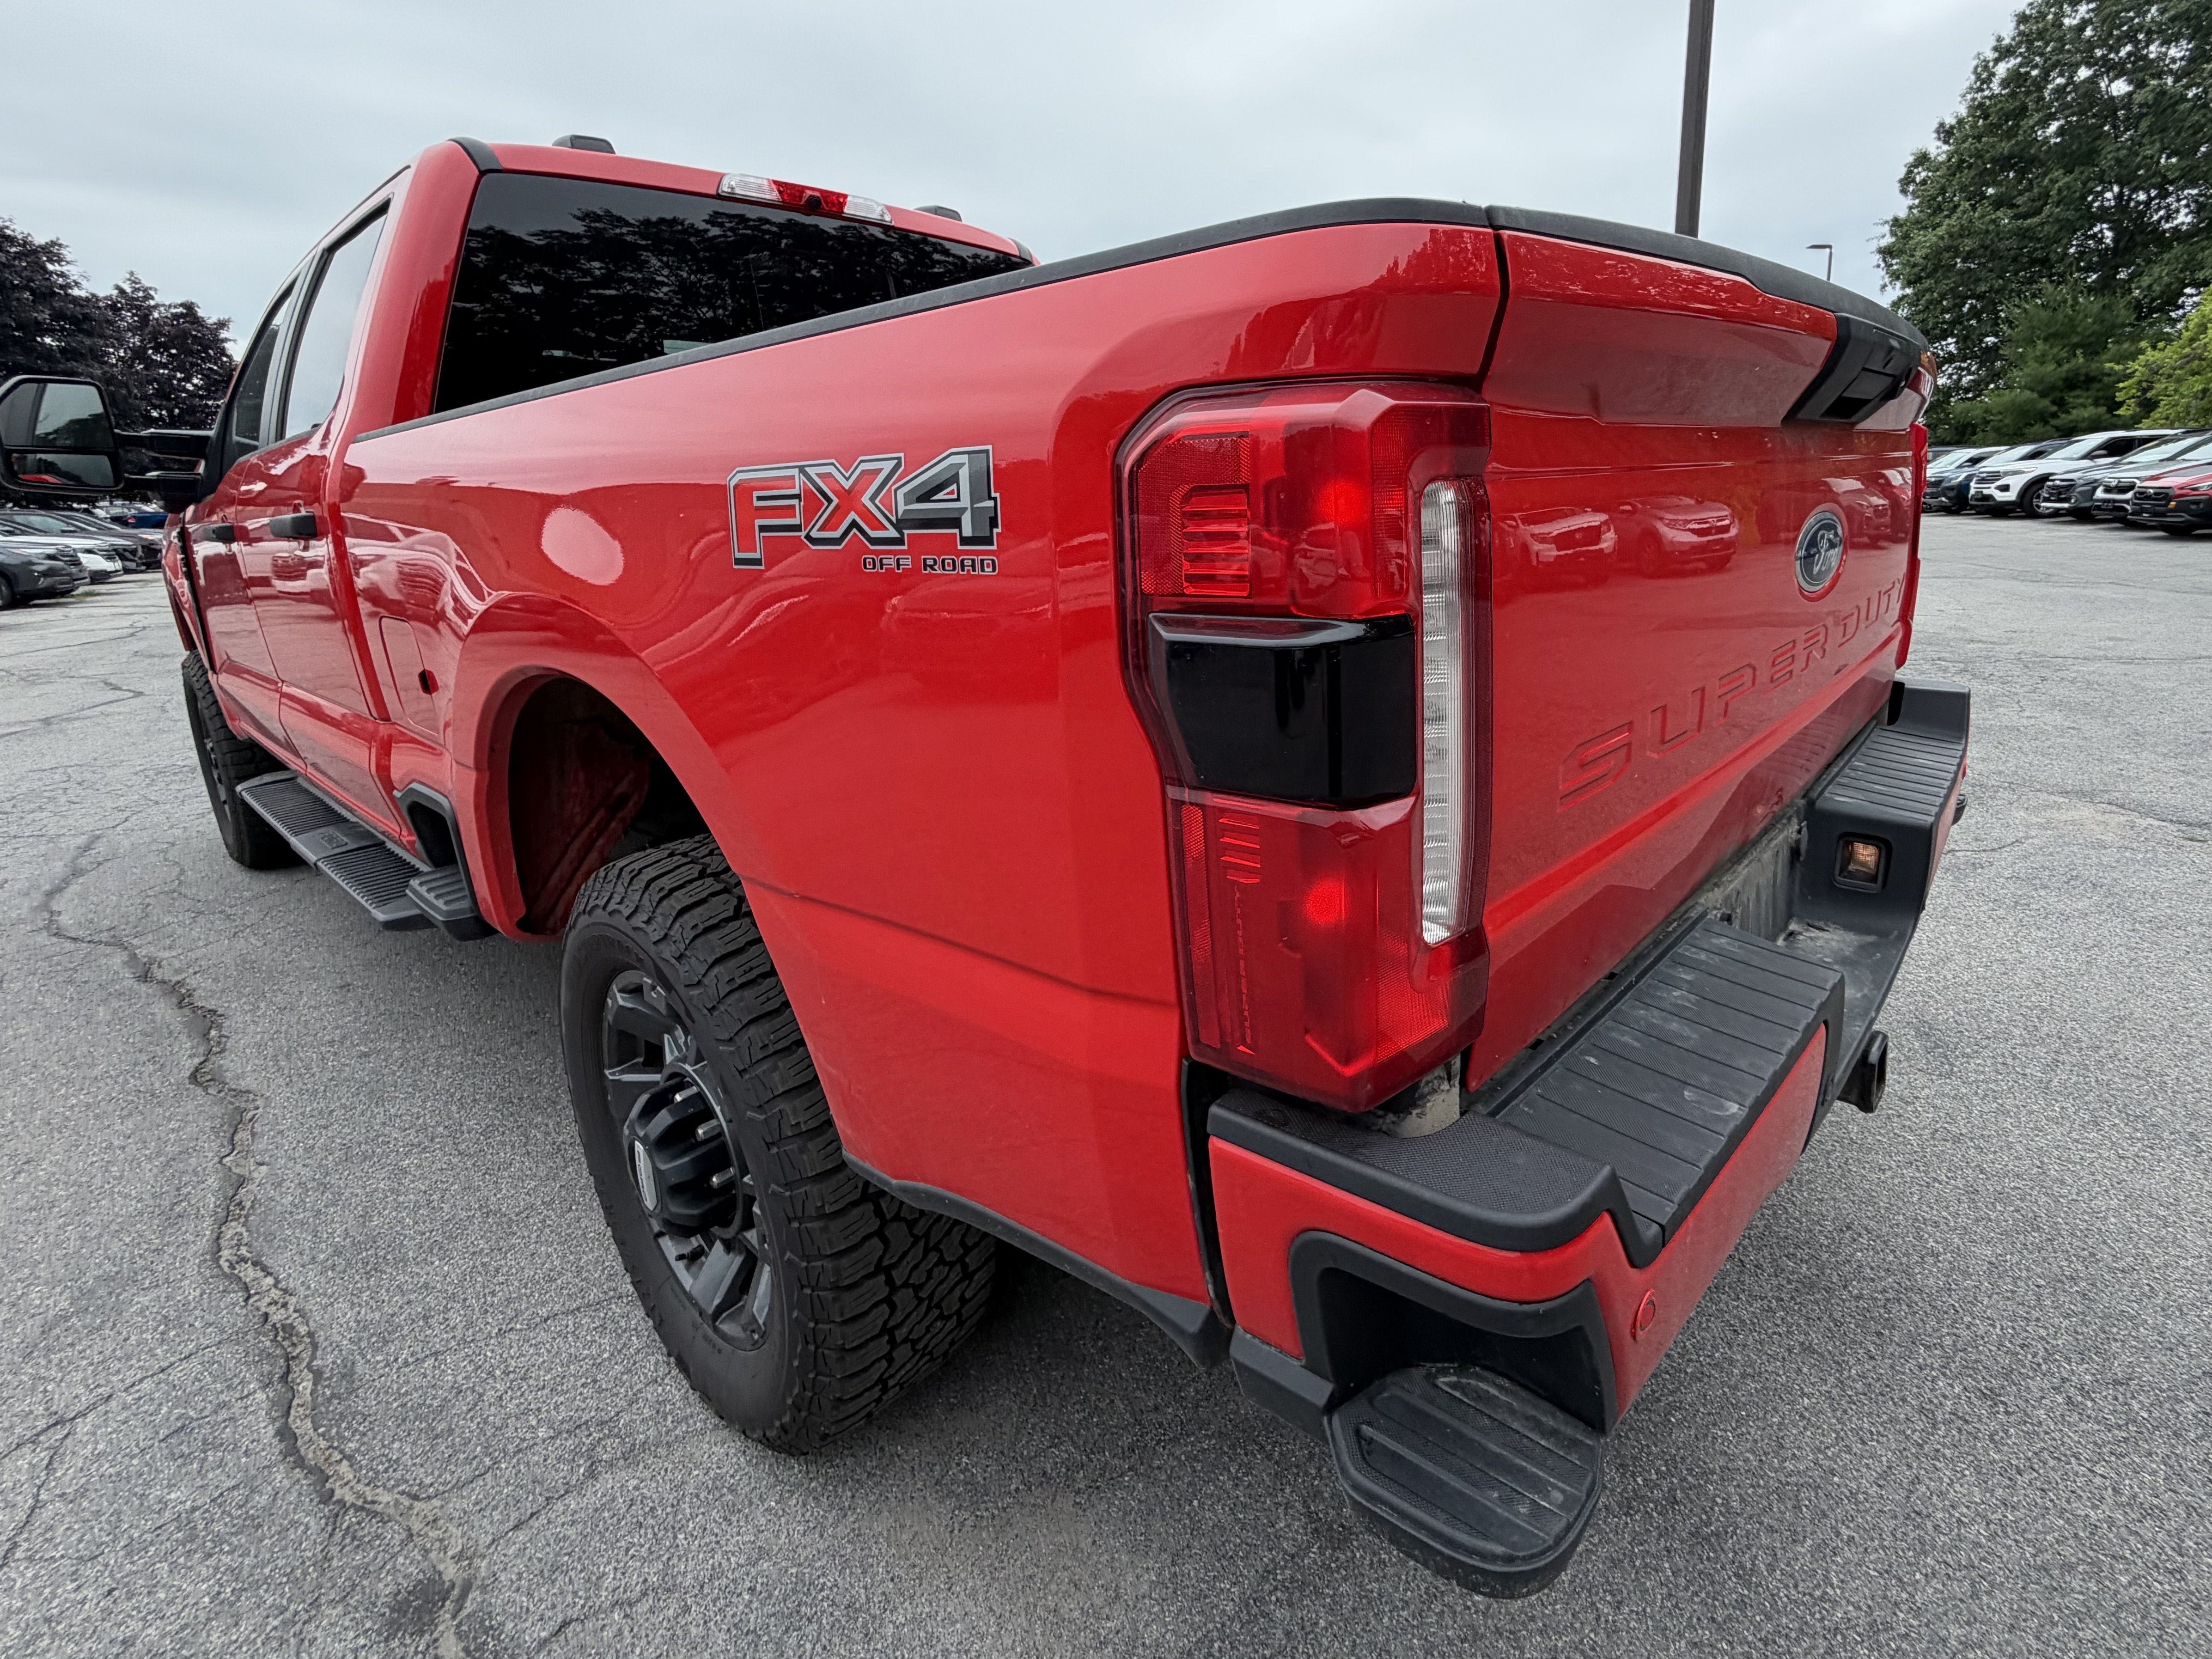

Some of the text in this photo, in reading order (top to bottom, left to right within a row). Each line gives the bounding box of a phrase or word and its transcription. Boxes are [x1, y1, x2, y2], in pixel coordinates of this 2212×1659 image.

[727, 445, 1001, 569] FX4
[862, 555, 999, 574] OFF ROAD
[1812, 530, 1840, 575] Ford
[1557, 572, 1906, 813] SUPER DUTY
